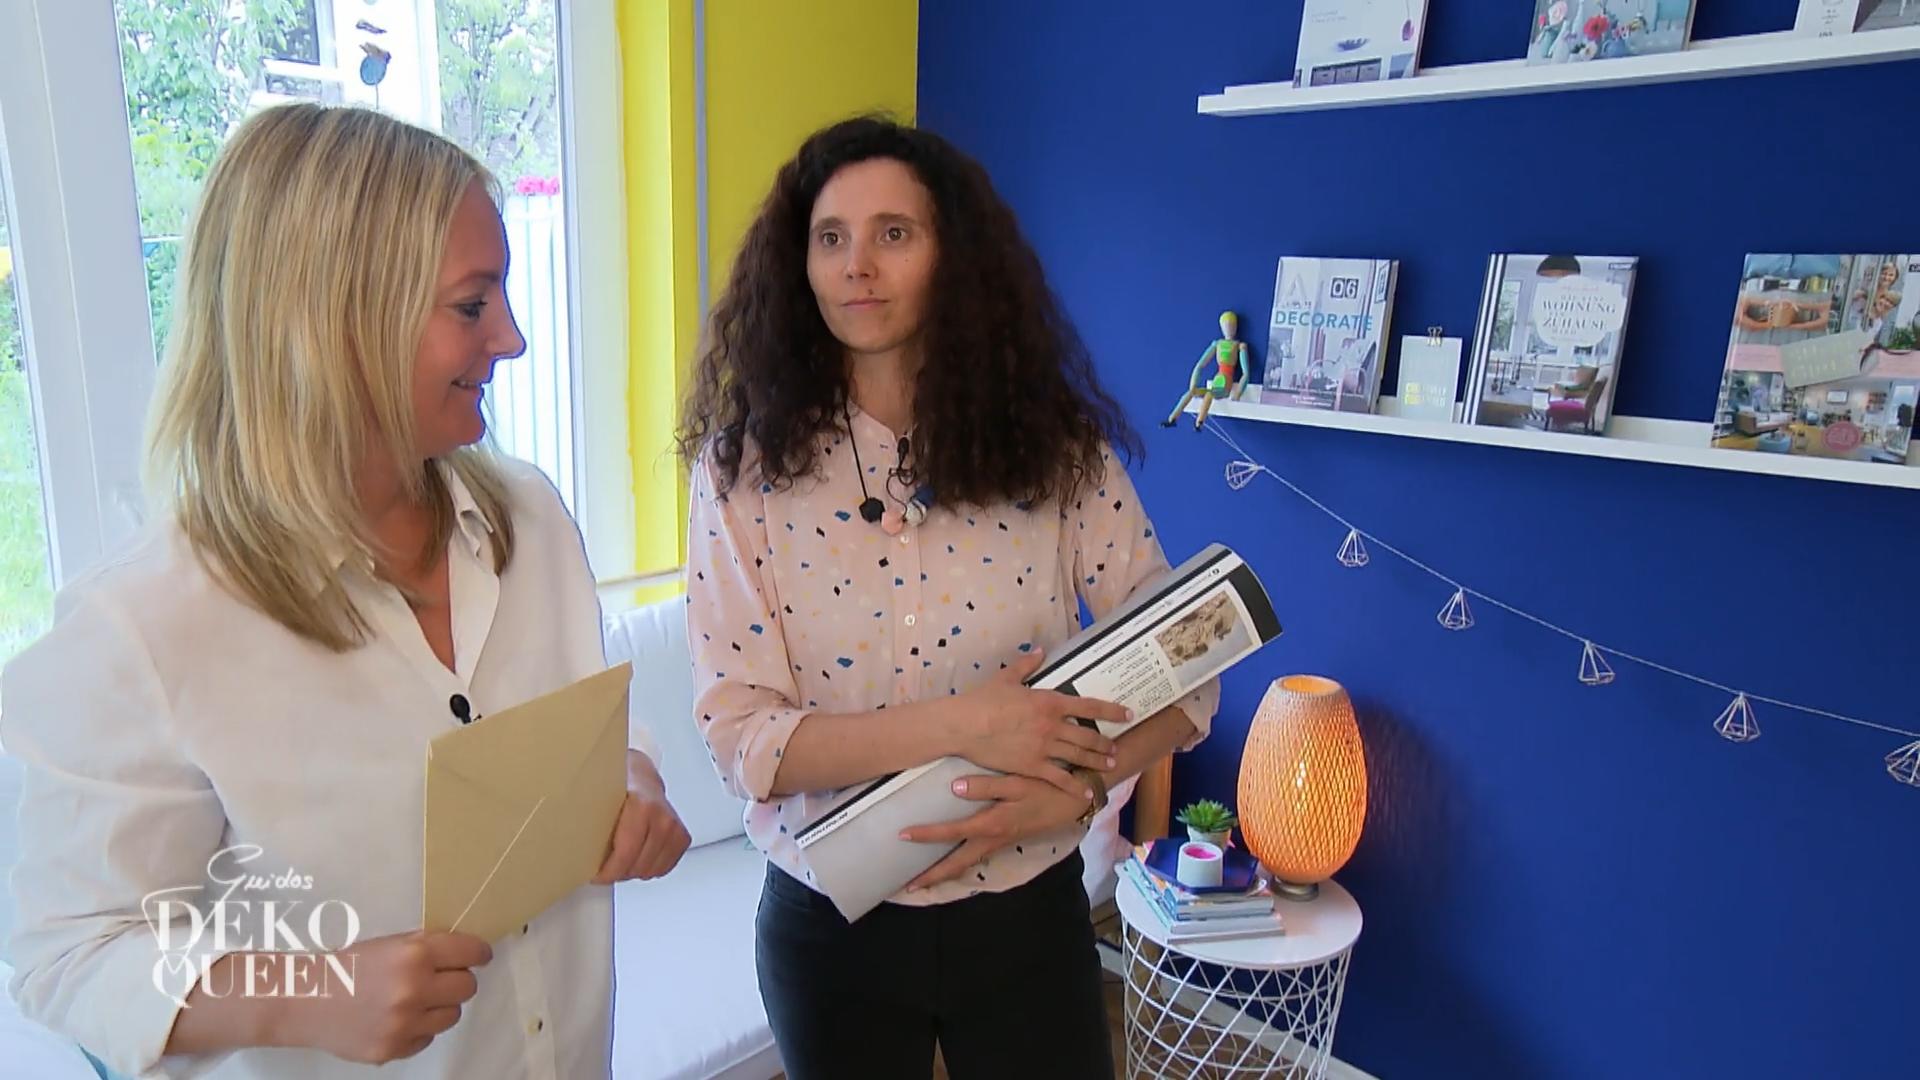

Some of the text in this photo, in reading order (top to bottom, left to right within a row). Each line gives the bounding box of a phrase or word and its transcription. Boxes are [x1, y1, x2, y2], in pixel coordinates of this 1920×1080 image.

[1331, 277, 1359, 299] 06
[1543, 300, 1616, 313] WOHNUNG
[1275, 310, 1373, 331] DECORATE
